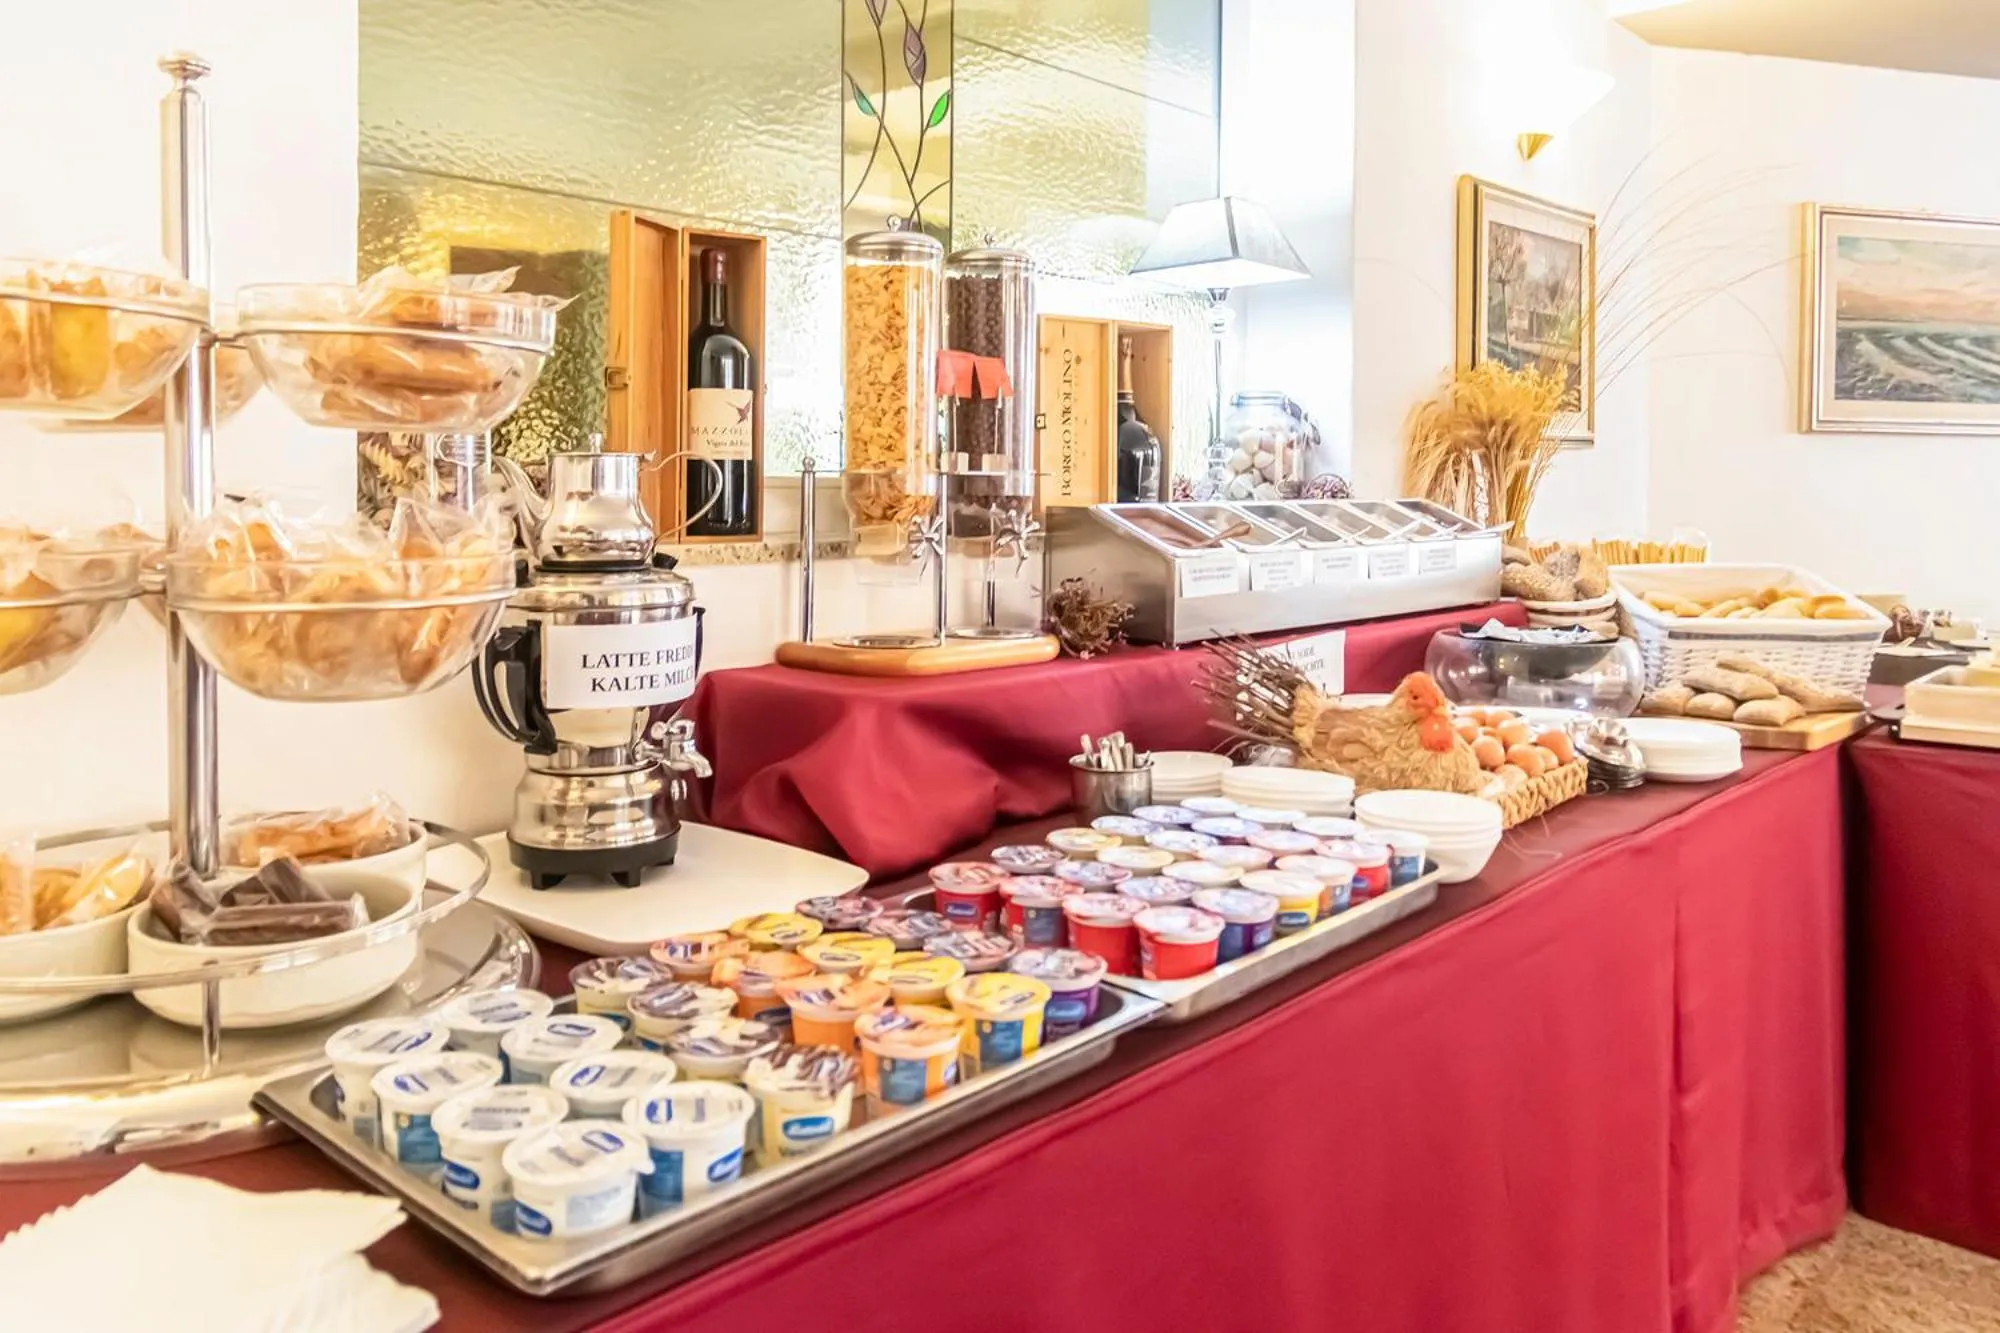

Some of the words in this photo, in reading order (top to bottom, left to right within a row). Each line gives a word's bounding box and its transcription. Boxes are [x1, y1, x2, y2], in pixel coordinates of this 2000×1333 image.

[1061, 348, 1073, 426] MOLINO
[1061, 429, 1072, 496] BORGO
[581, 651, 650, 669] LATTE
[656, 644, 693, 665] FREDD
[591, 674, 660, 692] KALTE
[664, 666, 693, 688] MILC
